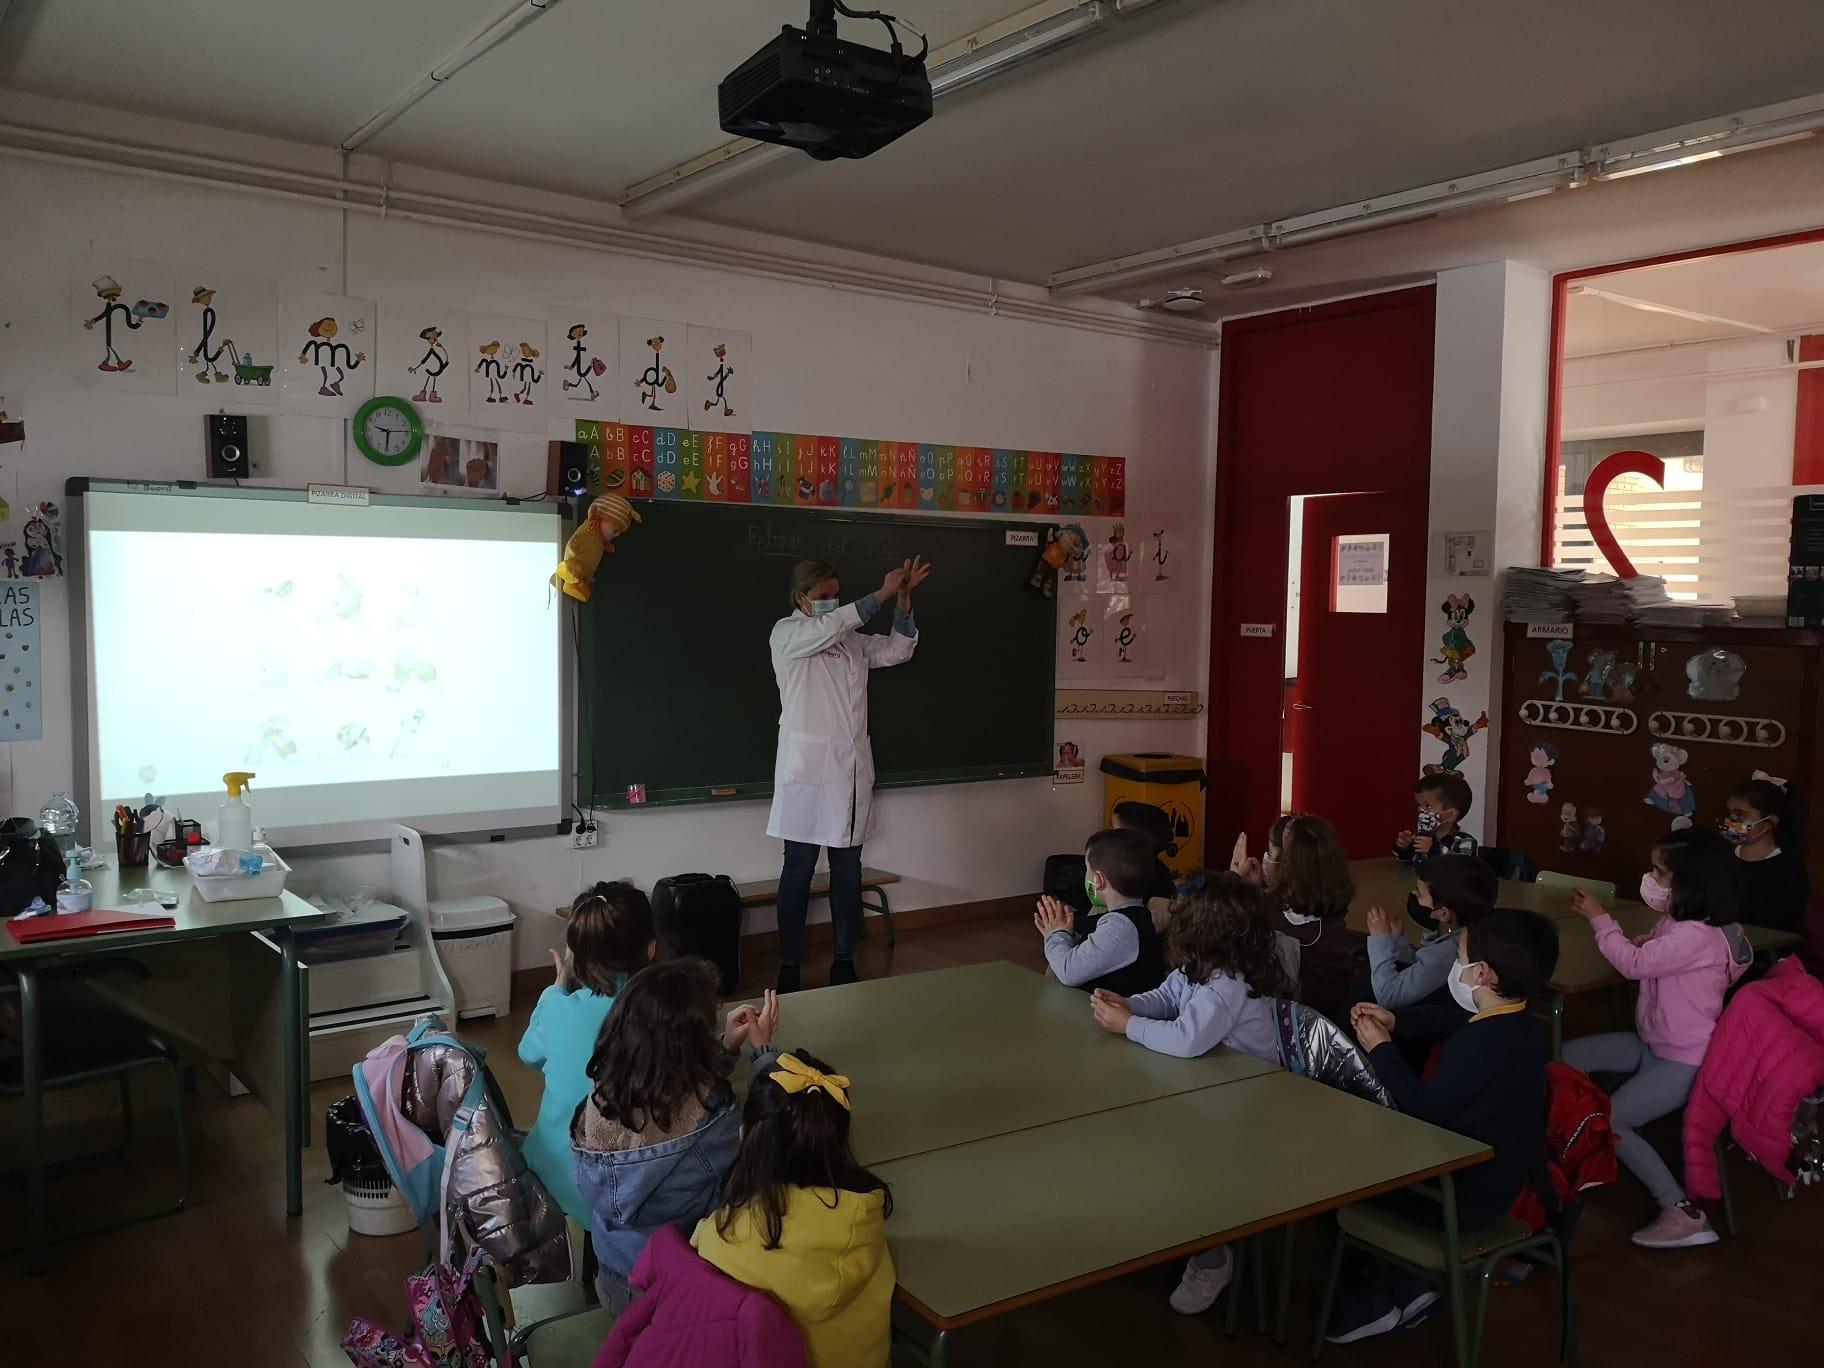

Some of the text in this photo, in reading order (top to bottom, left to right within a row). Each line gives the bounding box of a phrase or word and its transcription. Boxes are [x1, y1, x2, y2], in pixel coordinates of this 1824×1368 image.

[302, 340, 360, 369] m
[572, 340, 592, 378] t
[641, 352, 667, 387] d
[384, 408, 392, 417] 12
[311, 489, 368, 500] PIZARRA DIGITAL
[0, 586, 30, 605] AS
